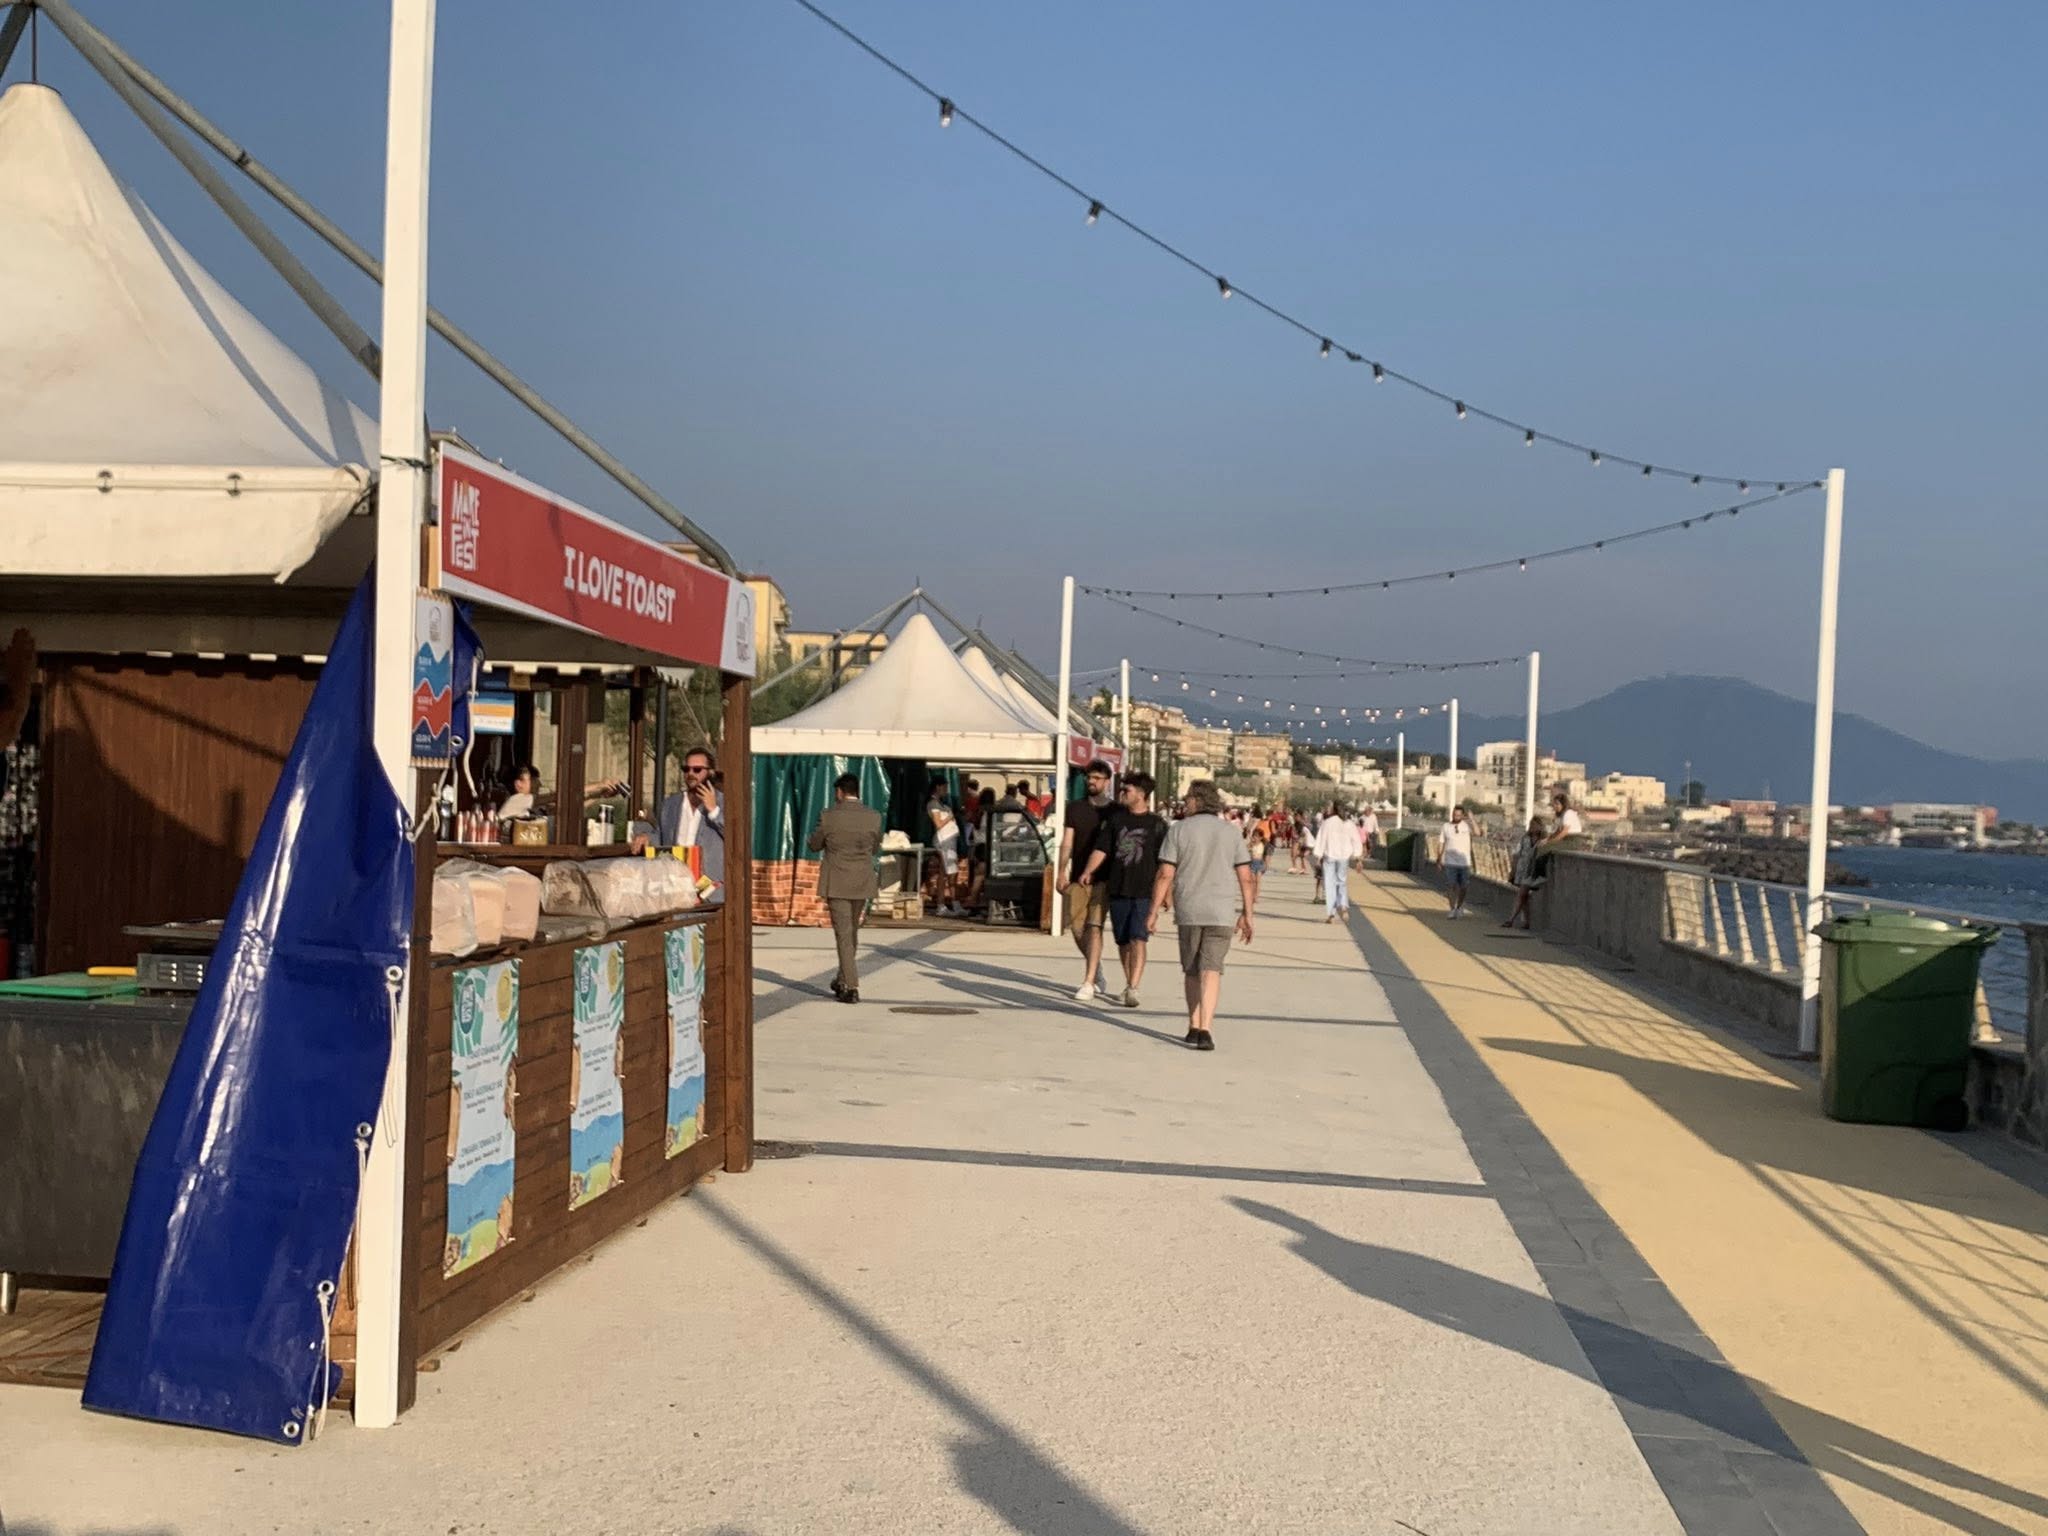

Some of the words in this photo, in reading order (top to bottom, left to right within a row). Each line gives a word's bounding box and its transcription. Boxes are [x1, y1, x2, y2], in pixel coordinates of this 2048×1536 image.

[564, 545, 576, 592] I
[578, 550, 624, 609] LOVE
[625, 568, 677, 624] TOAST
